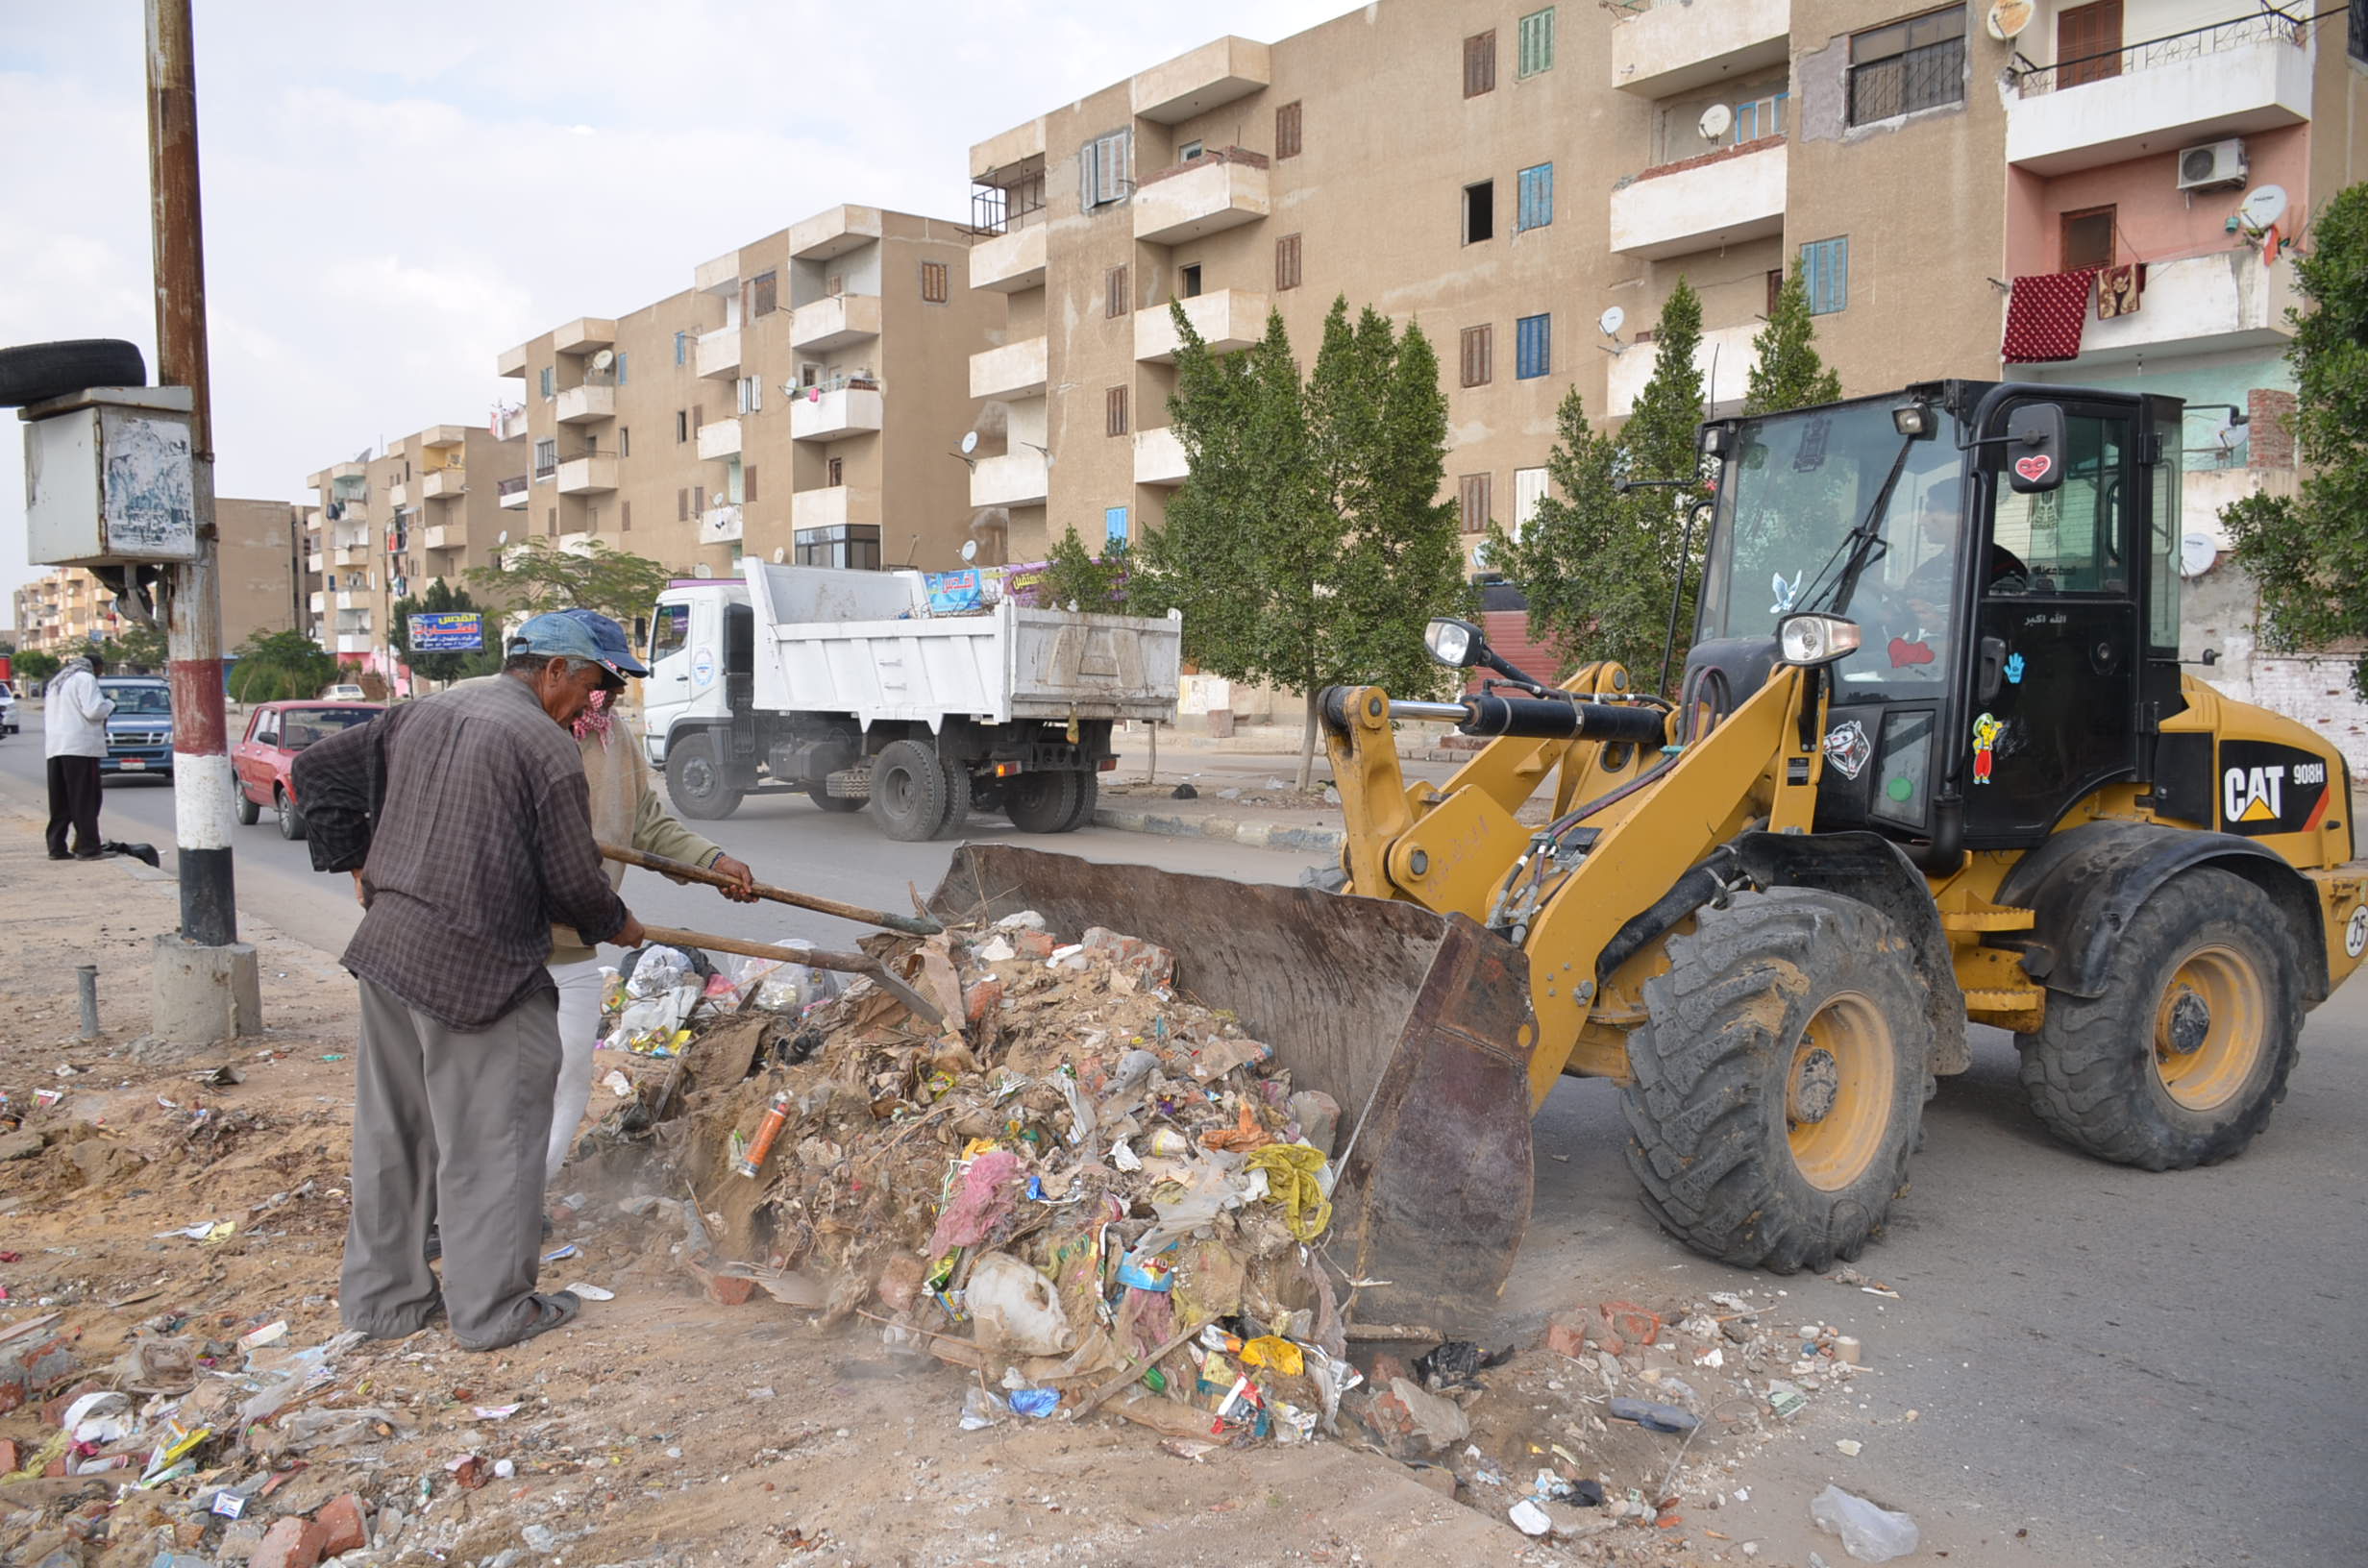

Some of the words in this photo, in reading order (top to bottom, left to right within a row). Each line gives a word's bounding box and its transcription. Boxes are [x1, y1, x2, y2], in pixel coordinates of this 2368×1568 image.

[2050, 613, 2066, 623] الله
[2293, 764, 2324, 785] 908H
[2224, 766, 2284, 822] CAT
